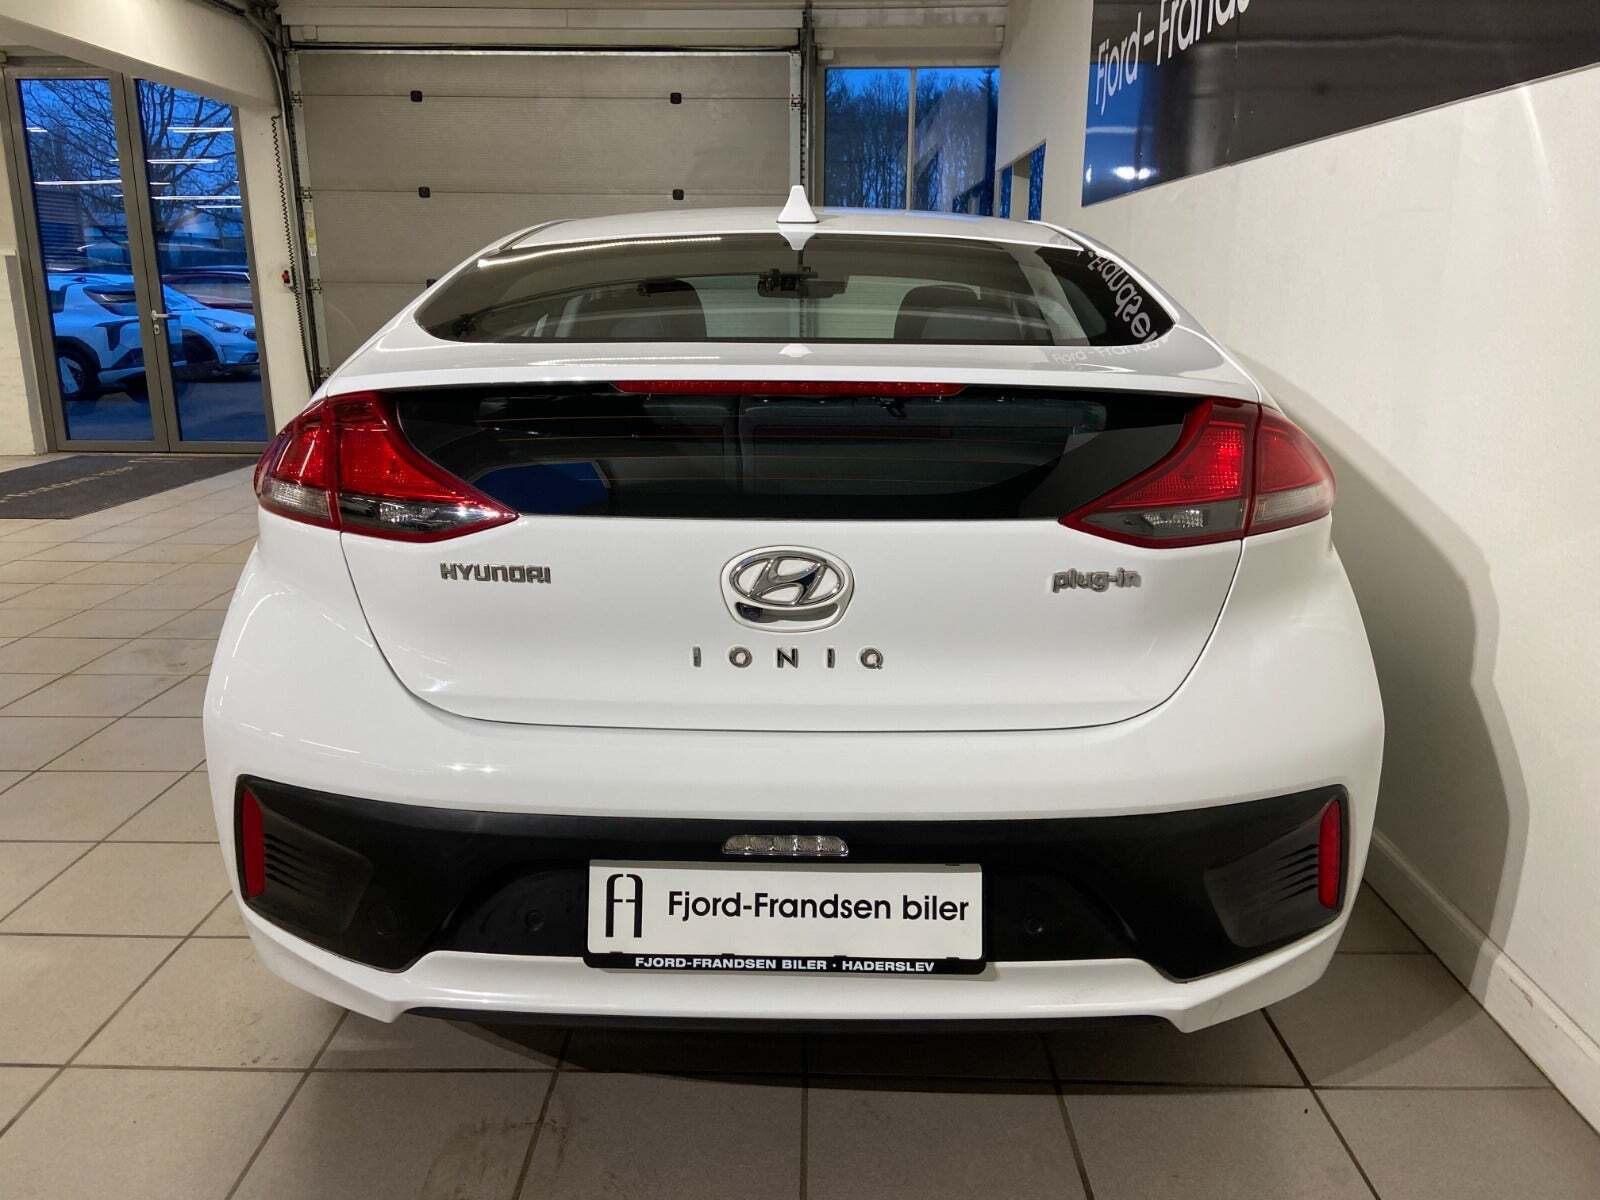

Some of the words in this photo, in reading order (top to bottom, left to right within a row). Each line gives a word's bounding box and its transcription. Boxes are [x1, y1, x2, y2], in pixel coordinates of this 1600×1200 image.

[1096, 0, 1250, 116] Fjord-Fran
[440, 562, 551, 584] HYUNDAI
[1052, 567, 1142, 593] plug-in
[692, 646, 884, 669] IONIQ
[668, 891, 891, 921] Fjord-Frandsen
[902, 894, 969, 921] biler
[635, 957, 776, 970] FJORD-FRANDSEN
[782, 959, 827, 971] BILER
[842, 960, 934, 973] HADERSLEV
